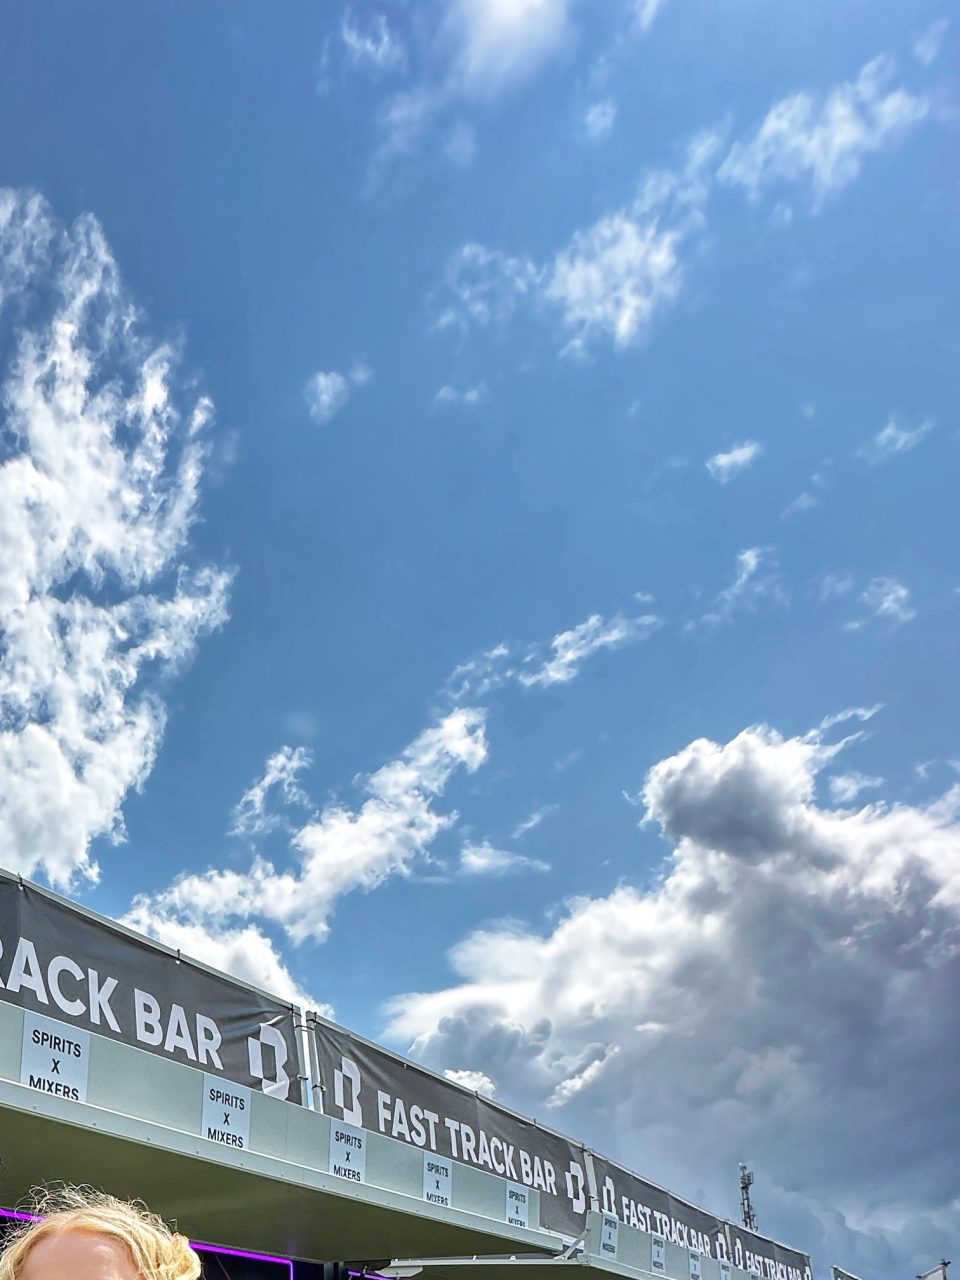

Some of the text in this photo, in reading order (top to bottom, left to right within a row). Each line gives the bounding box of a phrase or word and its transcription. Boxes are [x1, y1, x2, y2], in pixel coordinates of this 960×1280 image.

[134, 988, 224, 1070] BAR
[32, 1029, 81, 1057] SPIRITS
[51, 1058, 60, 1074] X
[29, 1075, 79, 1101] MIXERS
[209, 1088, 245, 1110] SPIRITS
[223, 1112, 230, 1126] X
[207, 1127, 243, 1148] MIXERS
[335, 1131, 362, 1149] SPIRITS
[377, 1090, 439, 1151] FAST
[445, 1118, 518, 1180] TRACK
[519, 1150, 557, 1195] BAR
[345, 1151, 351, 1162] X
[333, 1164, 361, 1181] MIXERS
[427, 1162, 449, 1177] SPIRITS
[622, 1196, 651, 1234] FAST
[654, 1211, 689, 1249] TRACK
[690, 1228, 712, 1258] BAR
